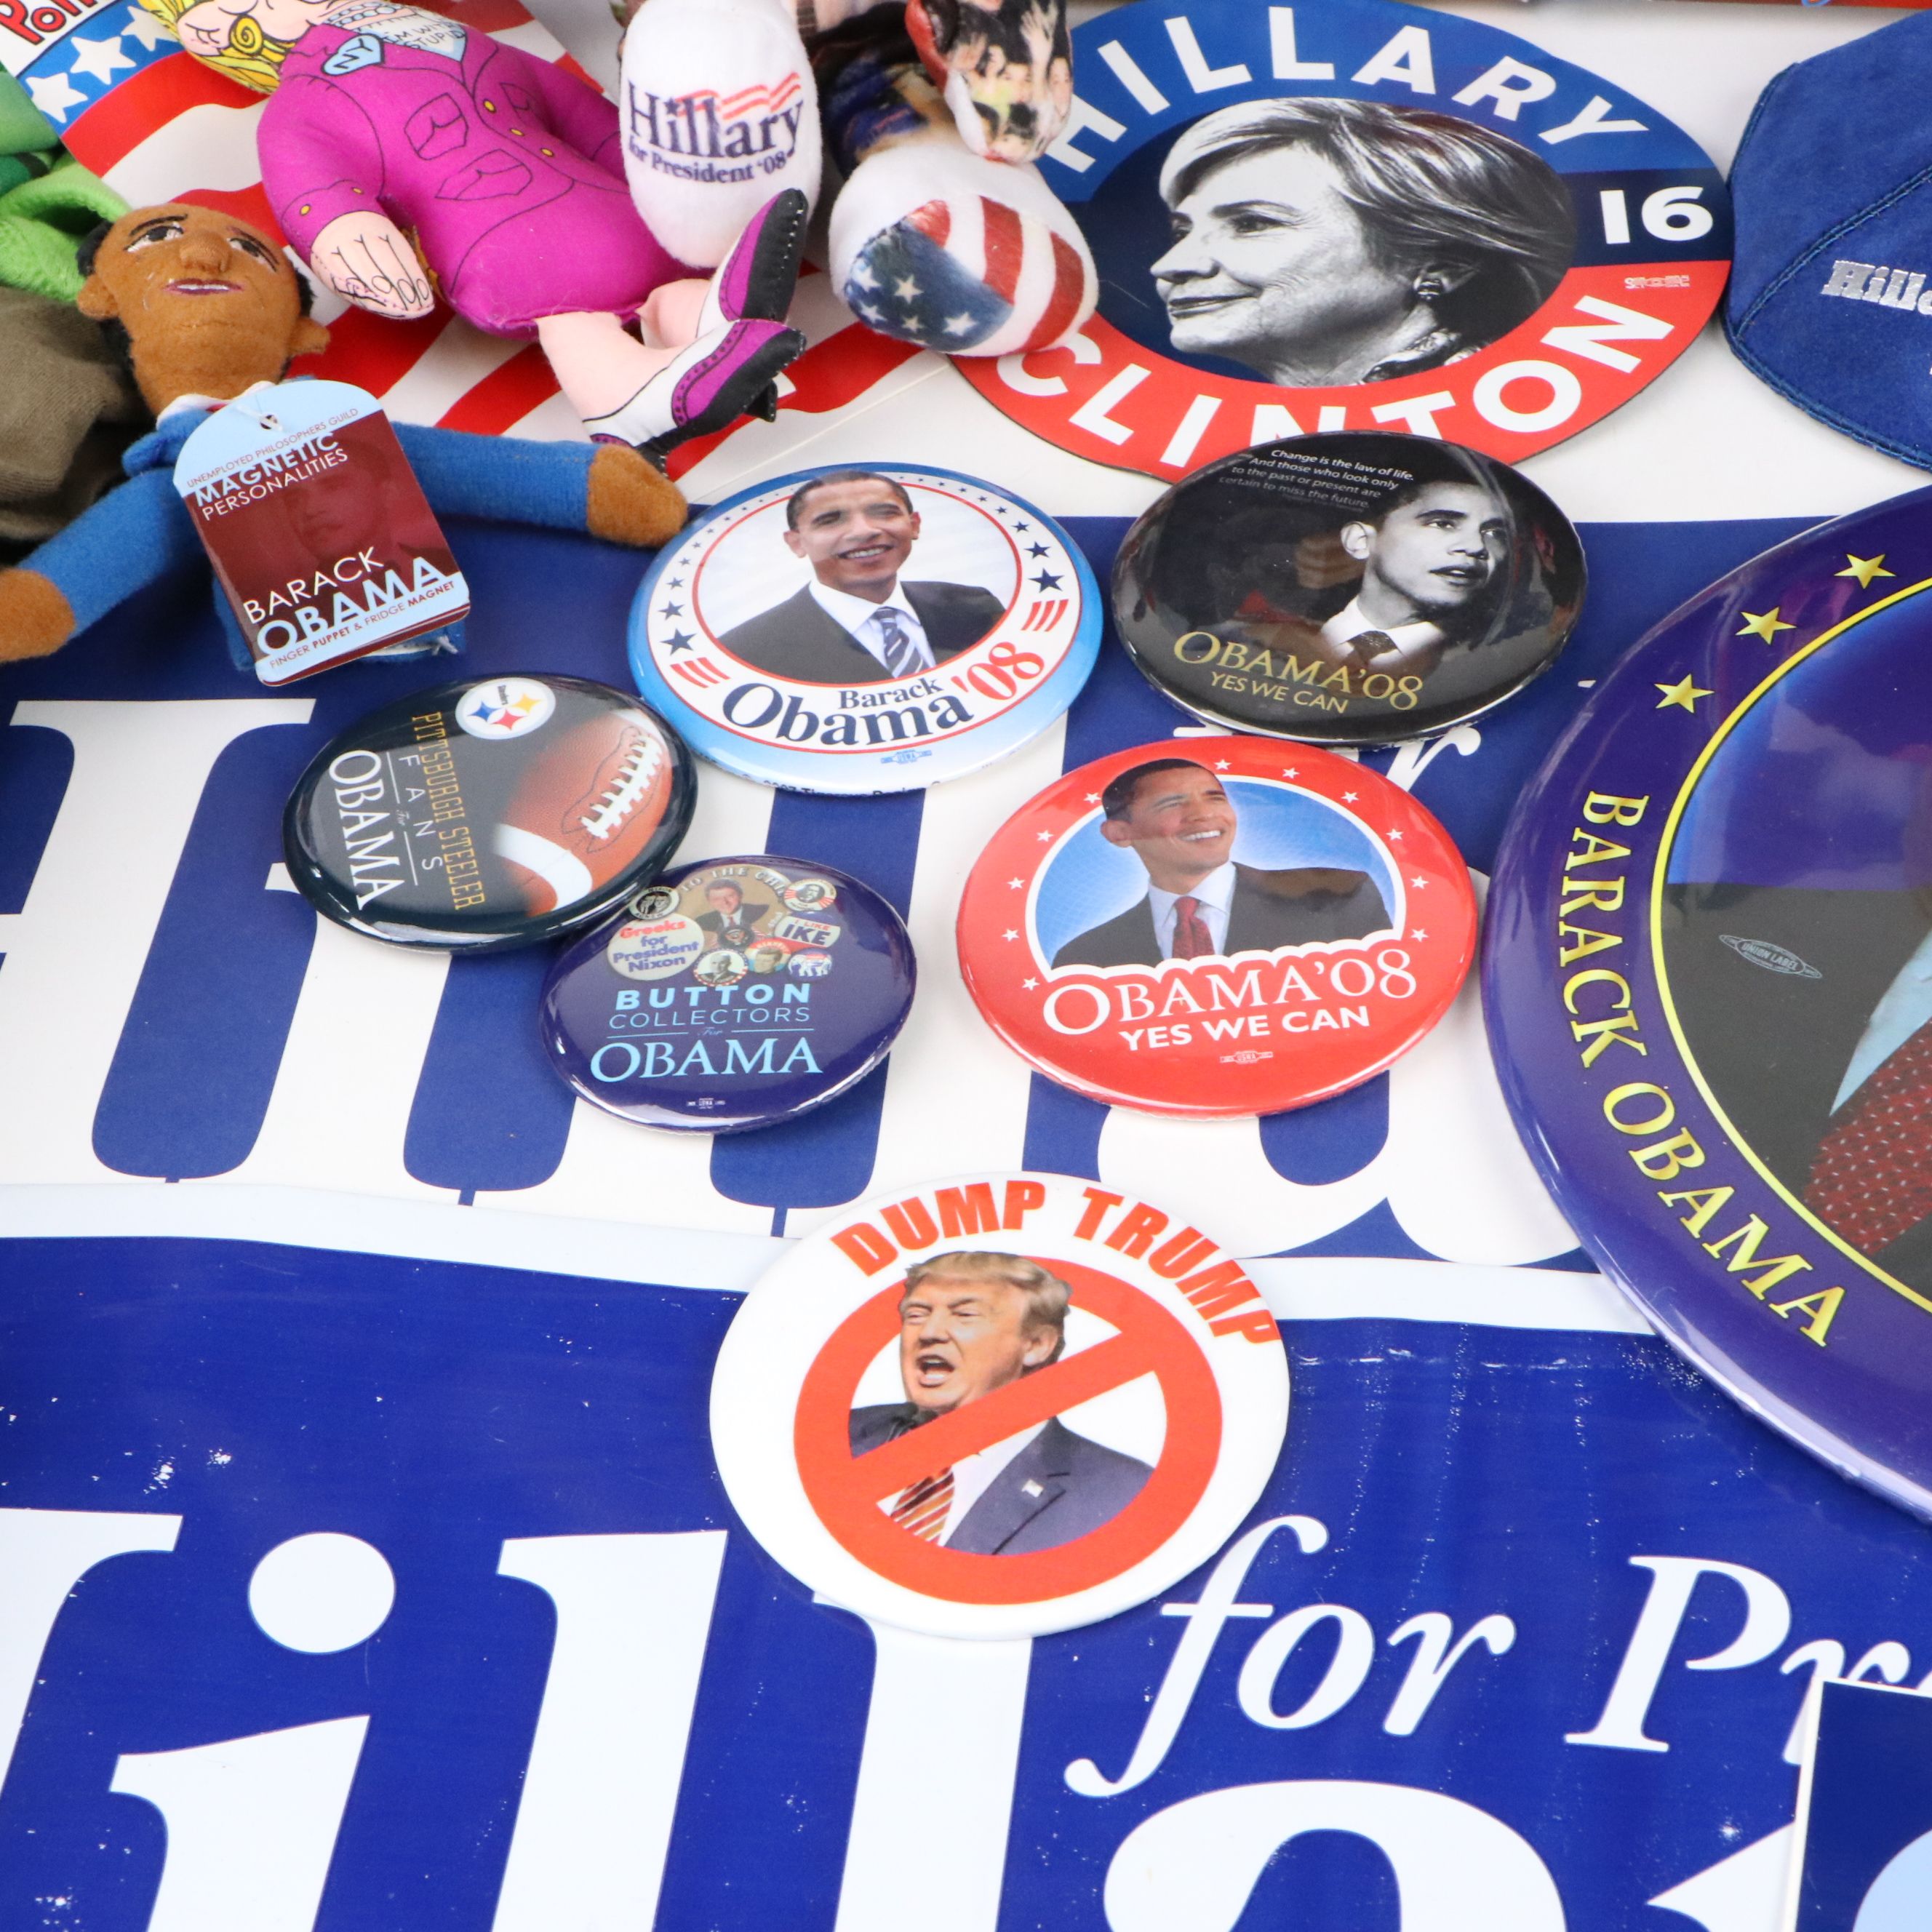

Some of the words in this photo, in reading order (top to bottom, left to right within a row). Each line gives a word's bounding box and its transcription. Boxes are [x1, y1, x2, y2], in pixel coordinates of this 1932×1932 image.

[1045, 6, 1650, 173] HILLARY
[628, 79, 804, 158] Hillary
[652, 151, 755, 183] President
[1600, 186, 1714, 244] 16
[187, 454, 254, 488] UNEMPLOYED
[255, 422, 327, 458] PHILOSOPHERS
[329, 408, 359, 426] GUILD
[193, 431, 340, 507] MAGNETIC
[1271, 450, 1317, 464] Change
[1319, 455, 1330, 466] is
[1331, 458, 1352, 469] the
[1354, 463, 1377, 474] law
[1378, 467, 1392, 476] of
[1393, 469, 1415, 482] life.
[201, 448, 348, 522] PERSONALITIES
[1232, 466, 1245, 474] to
[1246, 467, 1267, 478] the
[1268, 471, 1296, 483] past
[1297, 476, 1312, 485] or
[1311, 479, 1359, 495] present
[1360, 487, 1381, 499] are
[1249, 457, 1274, 468] And
[1277, 460, 1312, 474] those
[1313, 466, 1341, 479] who
[1342, 471, 1369, 484] look
[1370, 477, 1400, 491] only
[1277, 485, 1306, 497] miss
[1307, 490, 1330, 500] the
[243, 546, 384, 624] BARACK
[257, 556, 450, 656] OBAMA
[269, 644, 311, 668] FINGER
[312, 626, 351, 650] PUPPET
[354, 621, 363, 631] &
[364, 602, 406, 626] FRIDGE
[407, 580, 455, 607] MAGNET
[722, 683, 975, 746] Obama
[951, 642, 1045, 701] '08
[838, 676, 944, 709] Barack
[1210, 671, 1248, 692] YES
[1251, 680, 1290, 702] WE
[1293, 690, 1349, 714] CAN
[329, 750, 405, 911] OBAMA
[399, 754, 444, 871] FANS
[412, 711, 466, 823] PITTSBURGH
[439, 826, 486, 911] STEELER
[619, 920, 687, 939] Greeks
[641, 935, 668, 947] for
[783, 923, 831, 946] IKE
[803, 921, 831, 931] LIKE
[1558, 791, 1650, 1069] BARACK
[612, 941, 700, 964] President
[628, 956, 686, 973] Nixon
[1741, 943, 1771, 959] UNION
[1770, 954, 1799, 972] LABEL
[608, 1007, 811, 1030] COLLECTORS
[615, 982, 812, 1012] BUTTON
[1118, 1024, 1192, 1051] YES
[1201, 1015, 1270, 1042] WE
[1282, 1005, 1370, 1033] CAN
[589, 1037, 824, 1084] OBAMA
[1602, 1081, 1847, 1348] OBAMA
[829, 1180, 1047, 1278] DUMP
[1073, 1187, 1282, 1346] TRUMP
[1063, 1515, 1517, 1797] for
